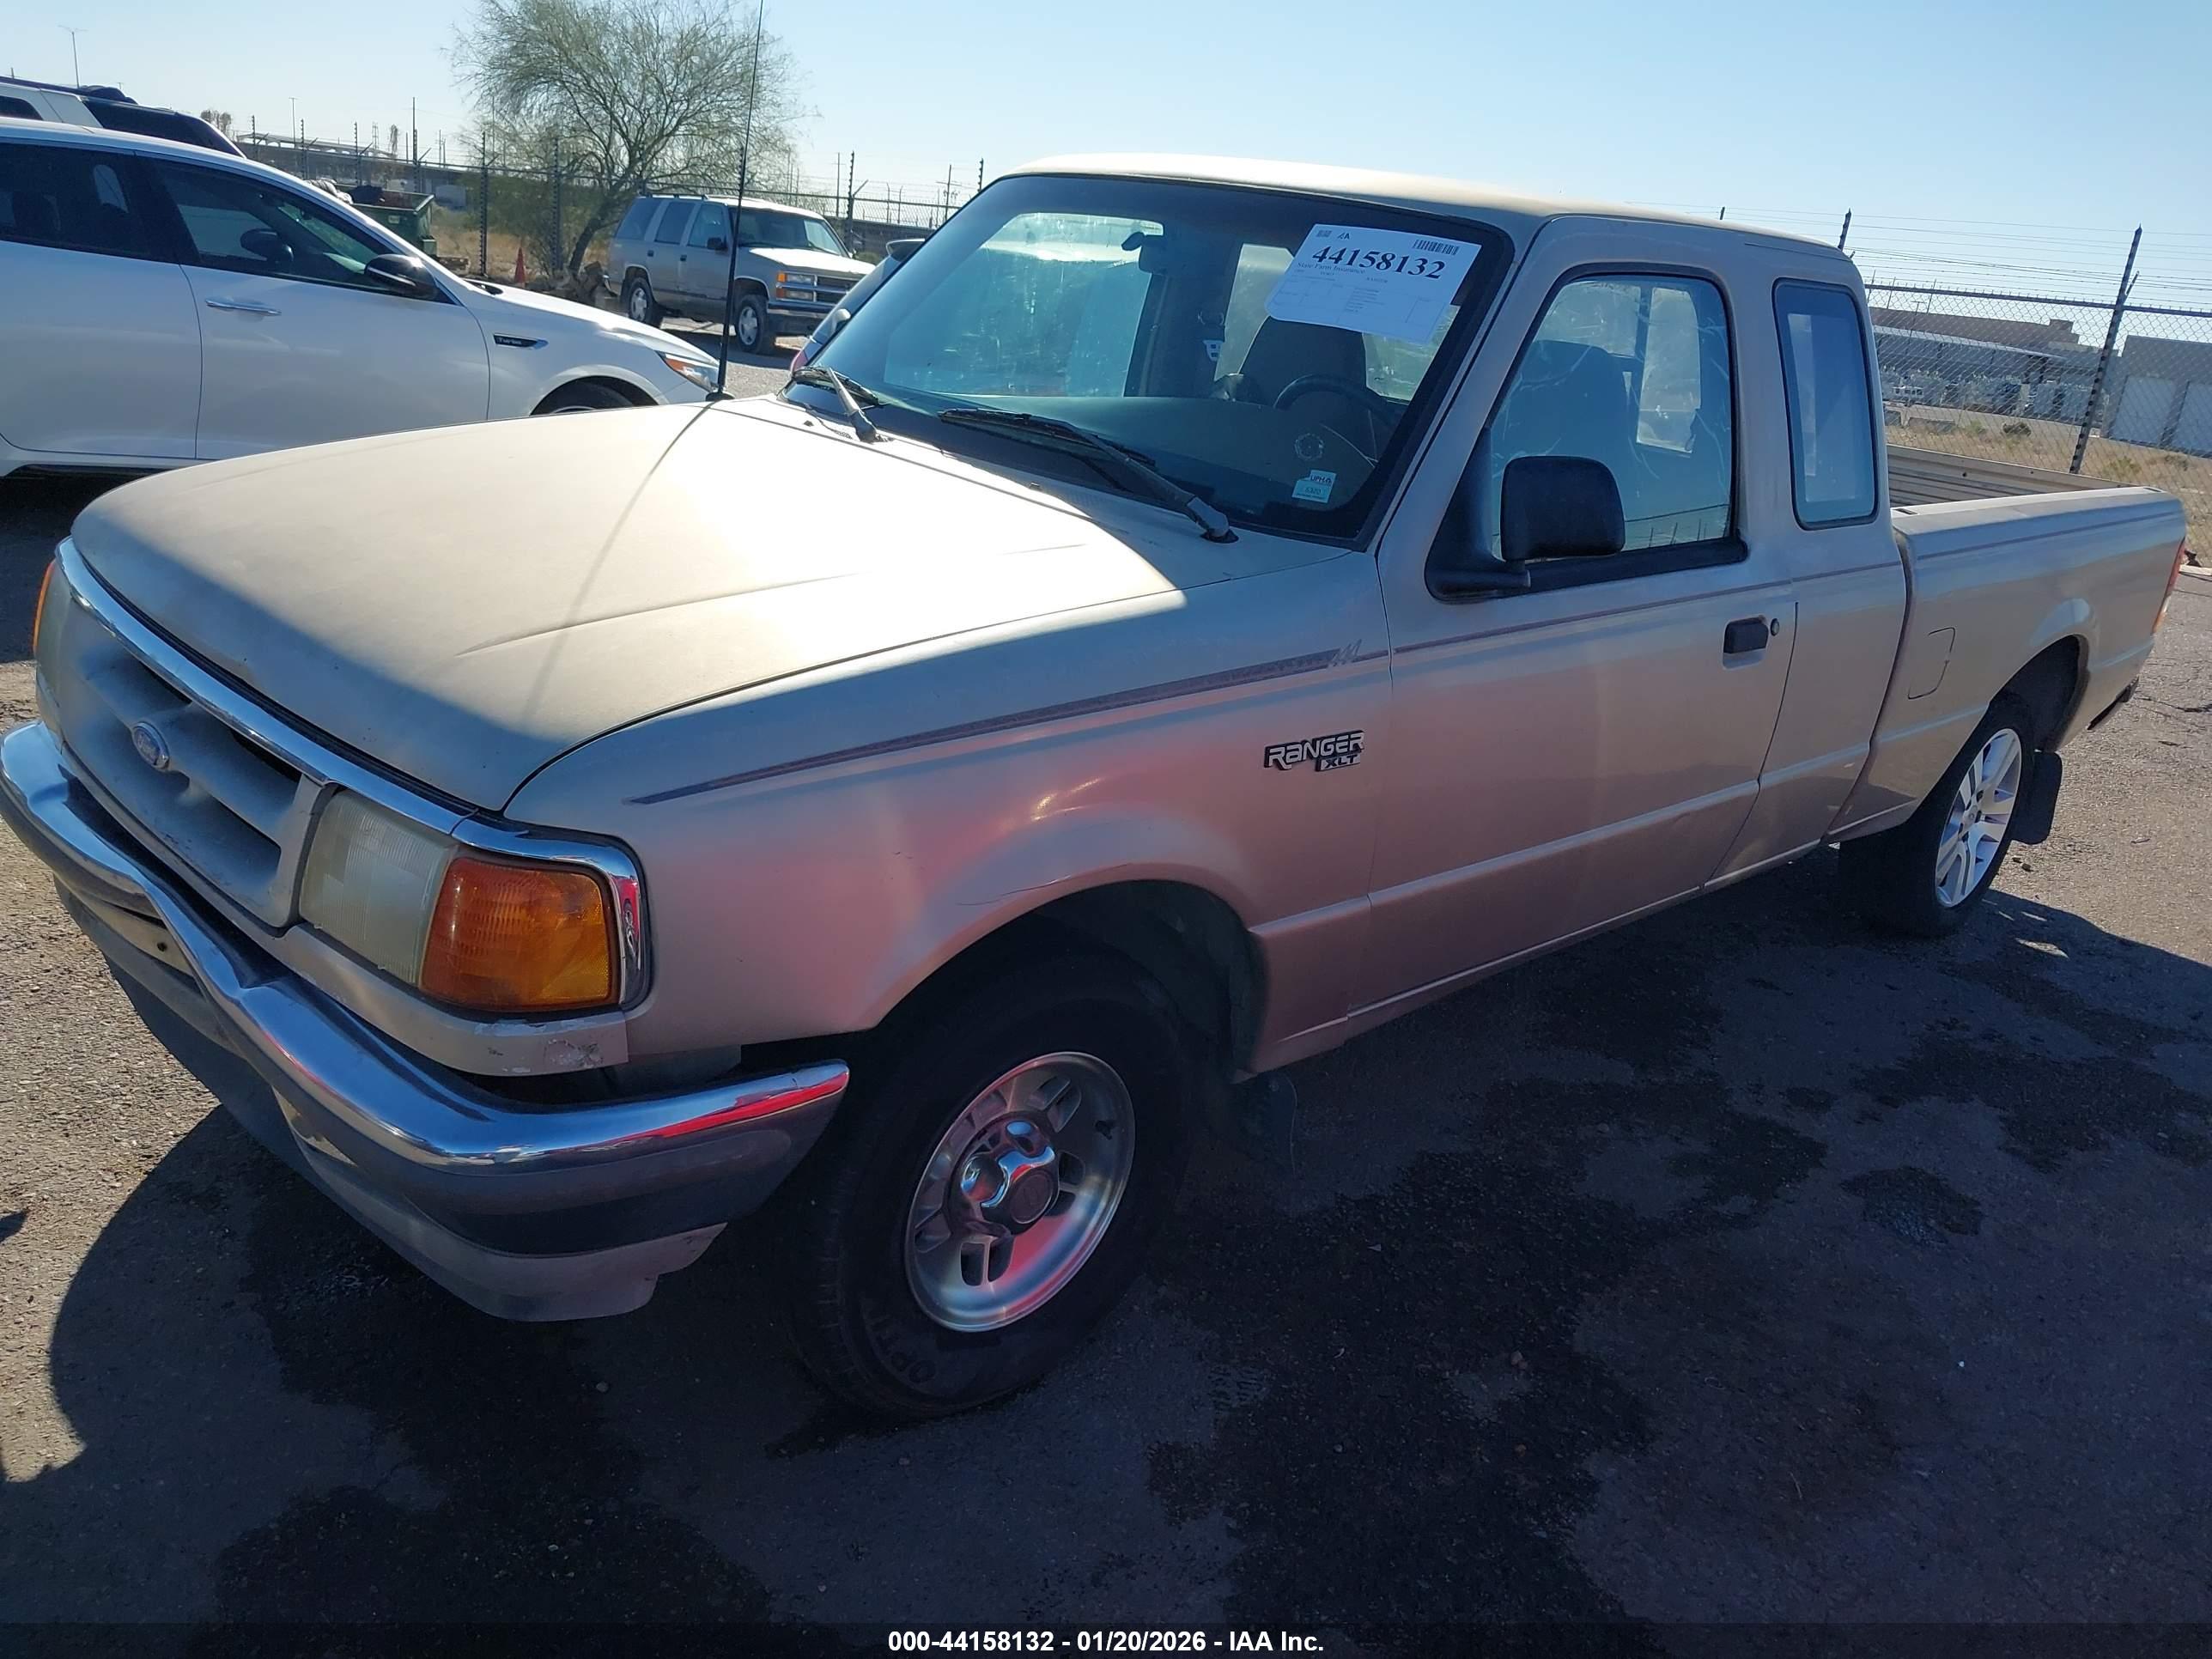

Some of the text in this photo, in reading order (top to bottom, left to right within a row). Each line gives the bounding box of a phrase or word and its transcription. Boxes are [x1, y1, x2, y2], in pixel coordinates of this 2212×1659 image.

[1312, 246, 1445, 279] 44158132
[1264, 731, 1364, 770] RANGER
[1320, 754, 1360, 770] XLT
